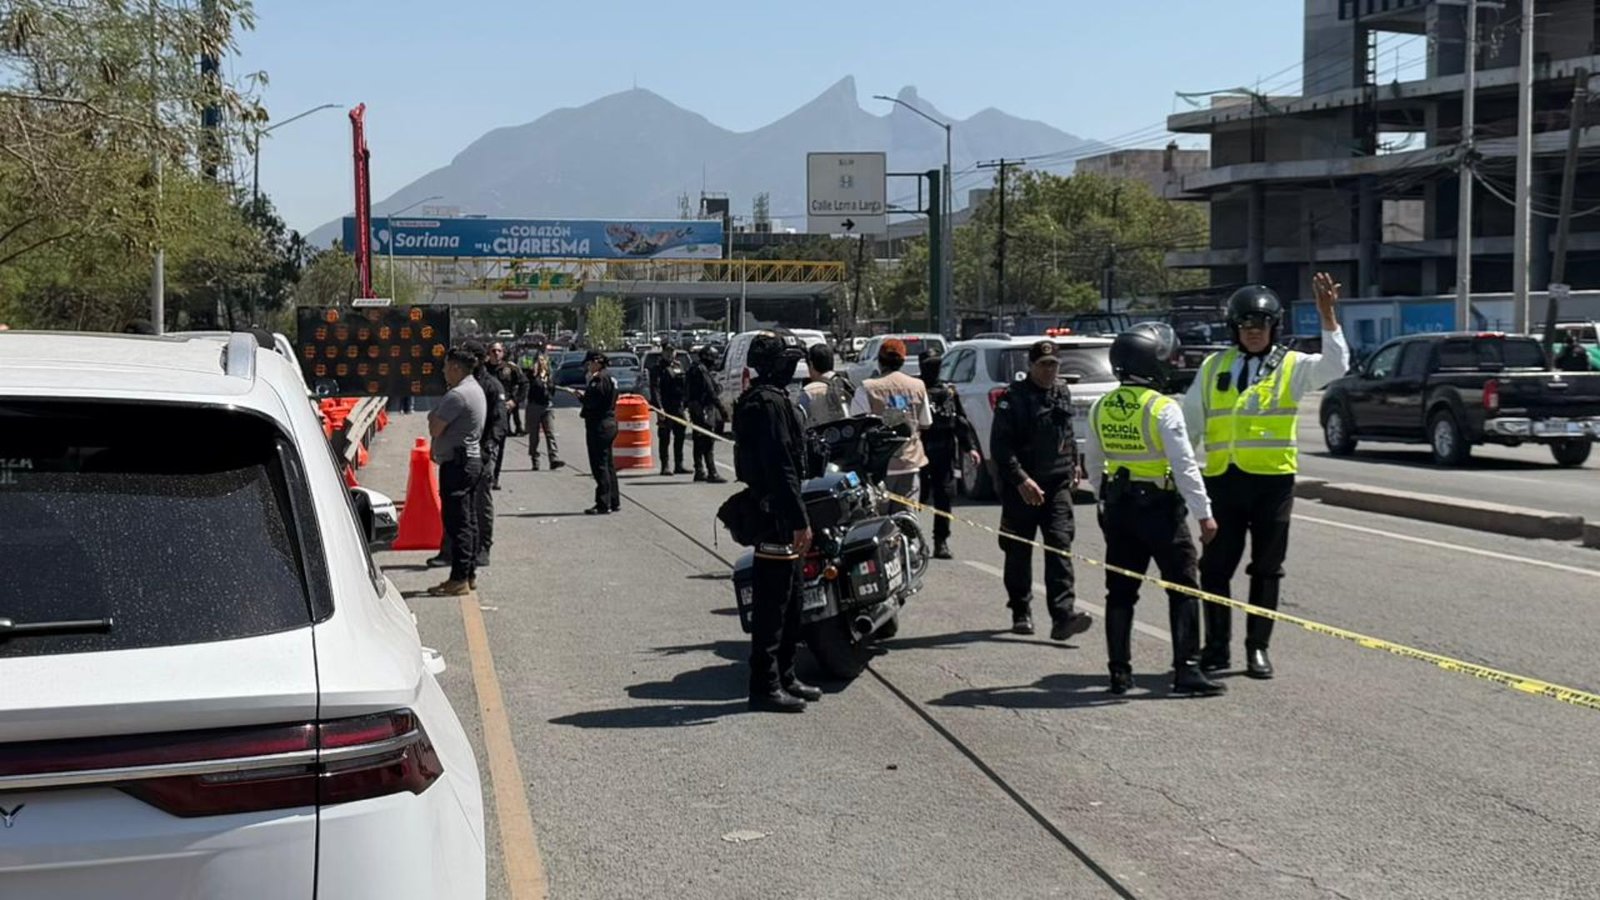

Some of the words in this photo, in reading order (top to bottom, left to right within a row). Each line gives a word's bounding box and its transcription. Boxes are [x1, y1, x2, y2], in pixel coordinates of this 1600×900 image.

[811, 200, 832, 211] Calle
[859, 200, 881, 213] Larga
[510, 222, 571, 237] CORAZÓN
[395, 232, 460, 248] Soriana
[493, 237, 590, 254] CUARESMA
[1101, 422, 1139, 434] POLICÍA
